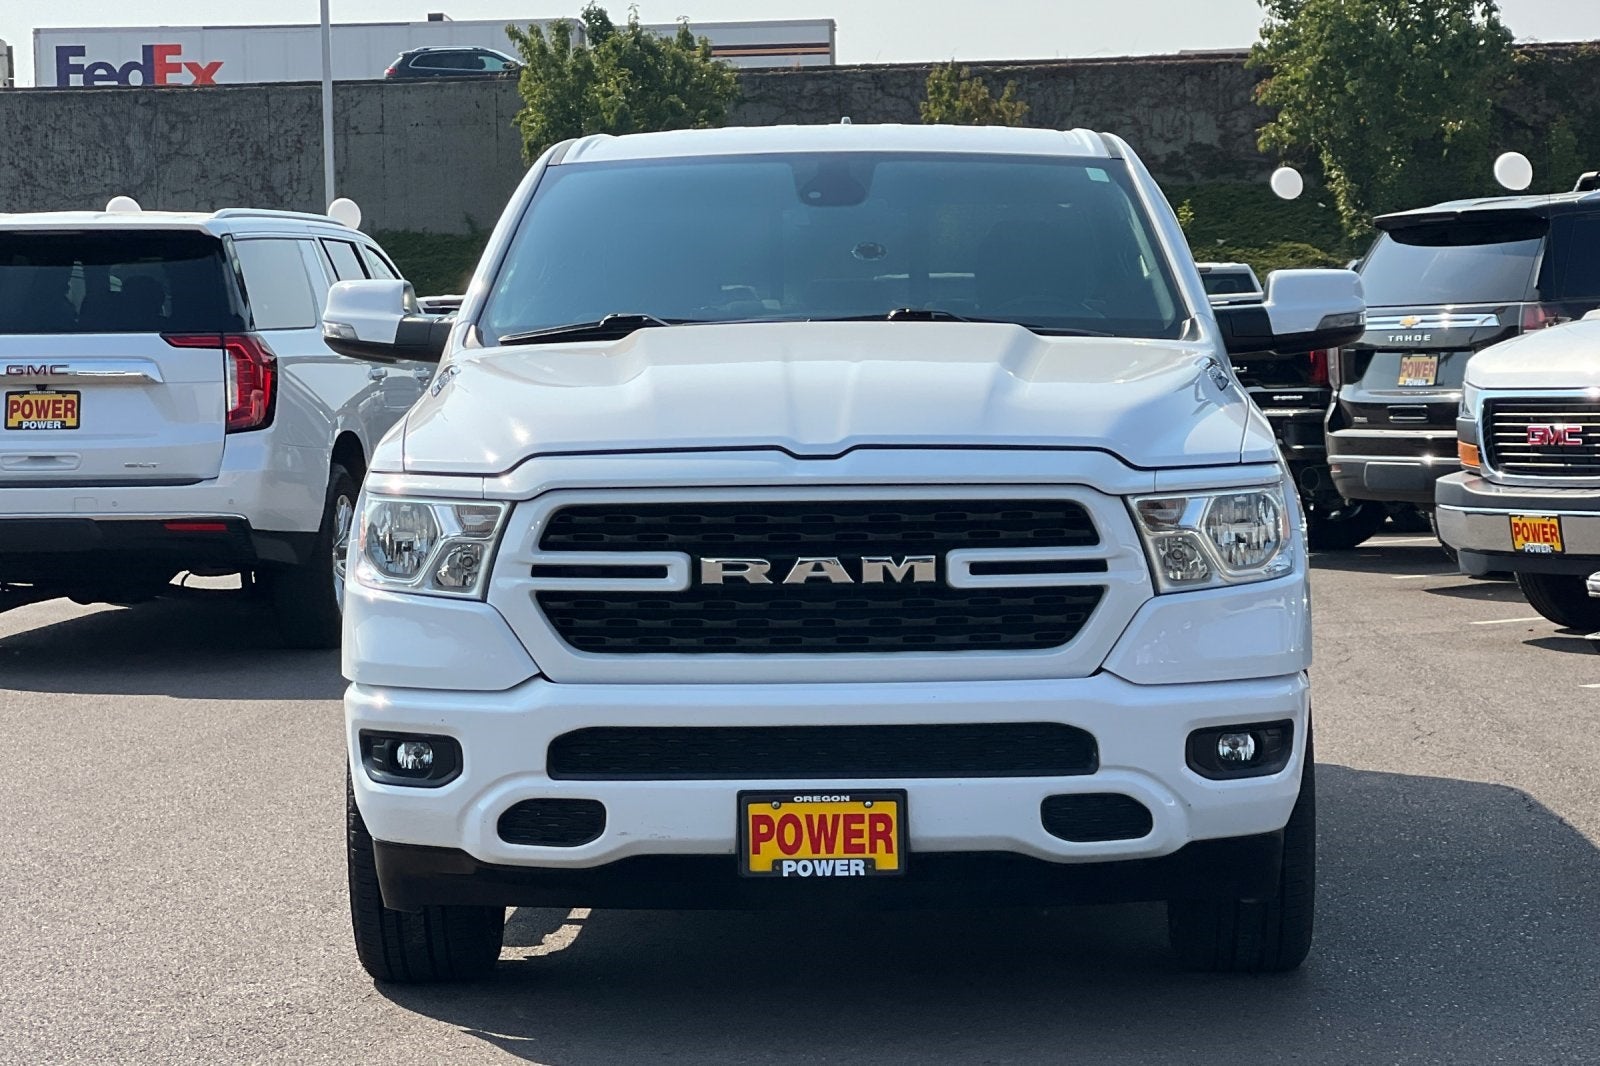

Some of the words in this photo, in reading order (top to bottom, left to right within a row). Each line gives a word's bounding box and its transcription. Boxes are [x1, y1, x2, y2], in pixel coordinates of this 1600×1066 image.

[56, 44, 224, 86] FedEx
[1388, 334, 1431, 342] TAHOE
[6, 364, 69, 376] GMC
[1402, 361, 1435, 377] POWER
[9, 399, 76, 419] POWER
[22, 421, 61, 429] POWER
[1527, 425, 1582, 445] GMC
[1513, 522, 1559, 543] POWER
[1524, 544, 1552, 553] POWER
[700, 555, 936, 584] RAM
[793, 795, 850, 803] OREGON
[751, 813, 894, 856] POWER
[782, 859, 865, 878] POWER
